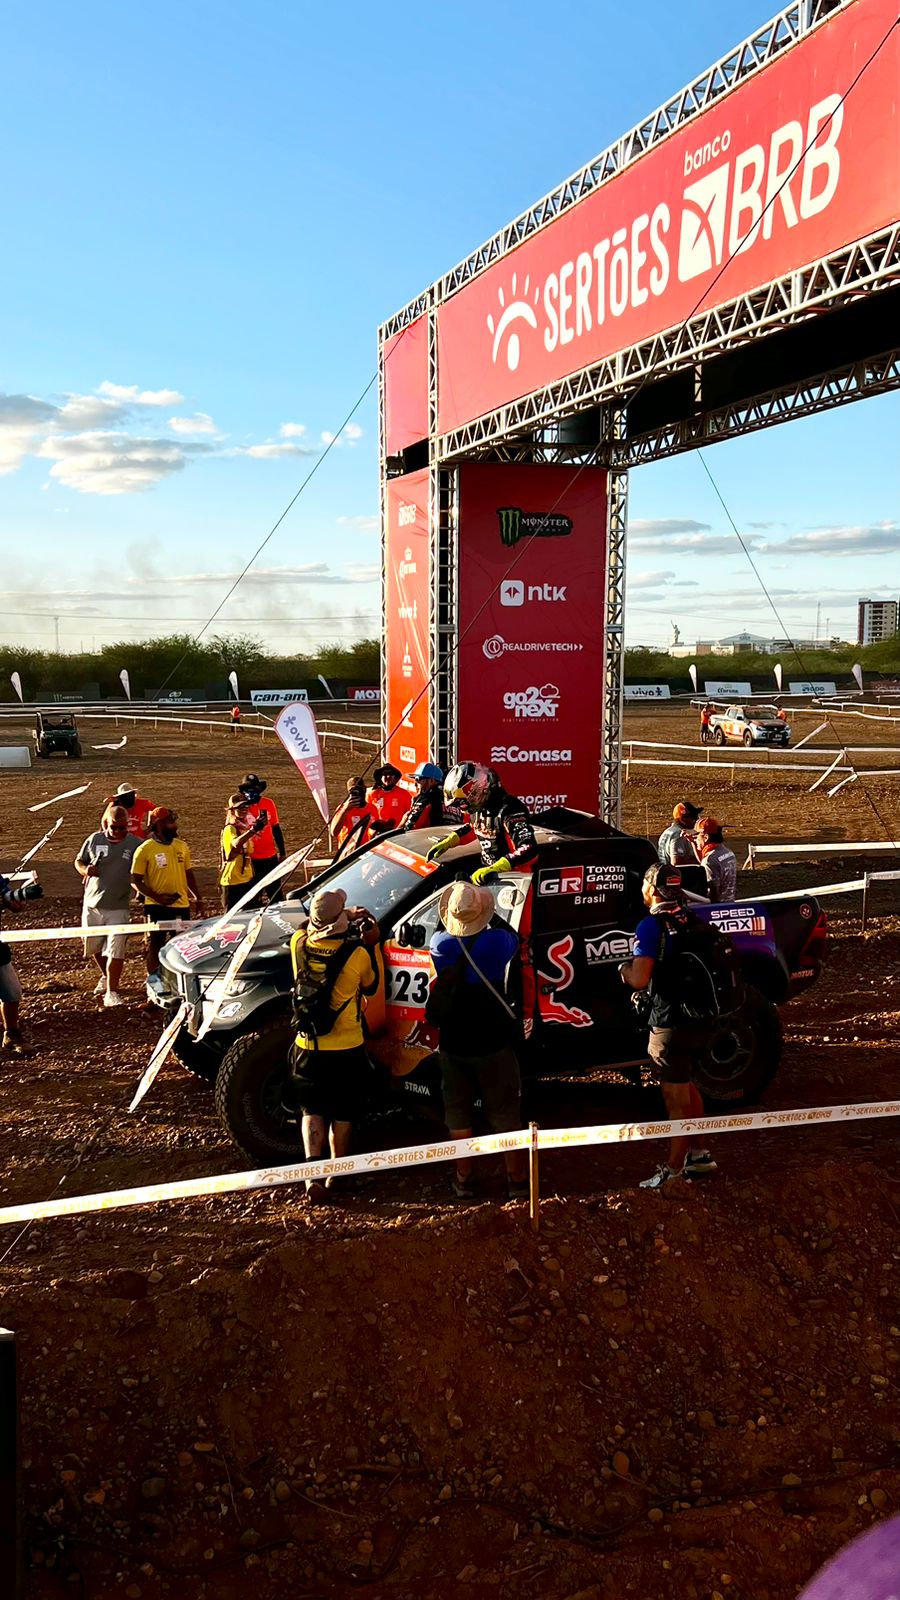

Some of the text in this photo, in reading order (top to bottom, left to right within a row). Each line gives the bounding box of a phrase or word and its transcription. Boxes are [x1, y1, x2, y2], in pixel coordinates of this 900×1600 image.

[684, 129, 731, 177] banco
[729, 92, 845, 257] BRB
[521, 517, 569, 527] MONSTER
[528, 583, 568, 601] ntk
[253, 692, 307, 702] can-am
[355, 690, 380, 700] MOT
[631, 688, 655, 696] vivo
[506, 746, 572, 762] Conasa
[586, 865, 627, 874] TOYOTA
[586, 874, 625, 882] GAZOO
[540, 877, 581, 894] GR
[586, 882, 624, 892] Racing
[574, 894, 606, 905] Brasil
[710, 908, 756, 919] SPEED
[790, 969, 815, 980] MOTUL
[404, 1081, 431, 1096] STRAVA
[654, 1124, 672, 1134] BRB
[436, 1145, 457, 1157] BRB
[333, 1161, 355, 1172] BRB
